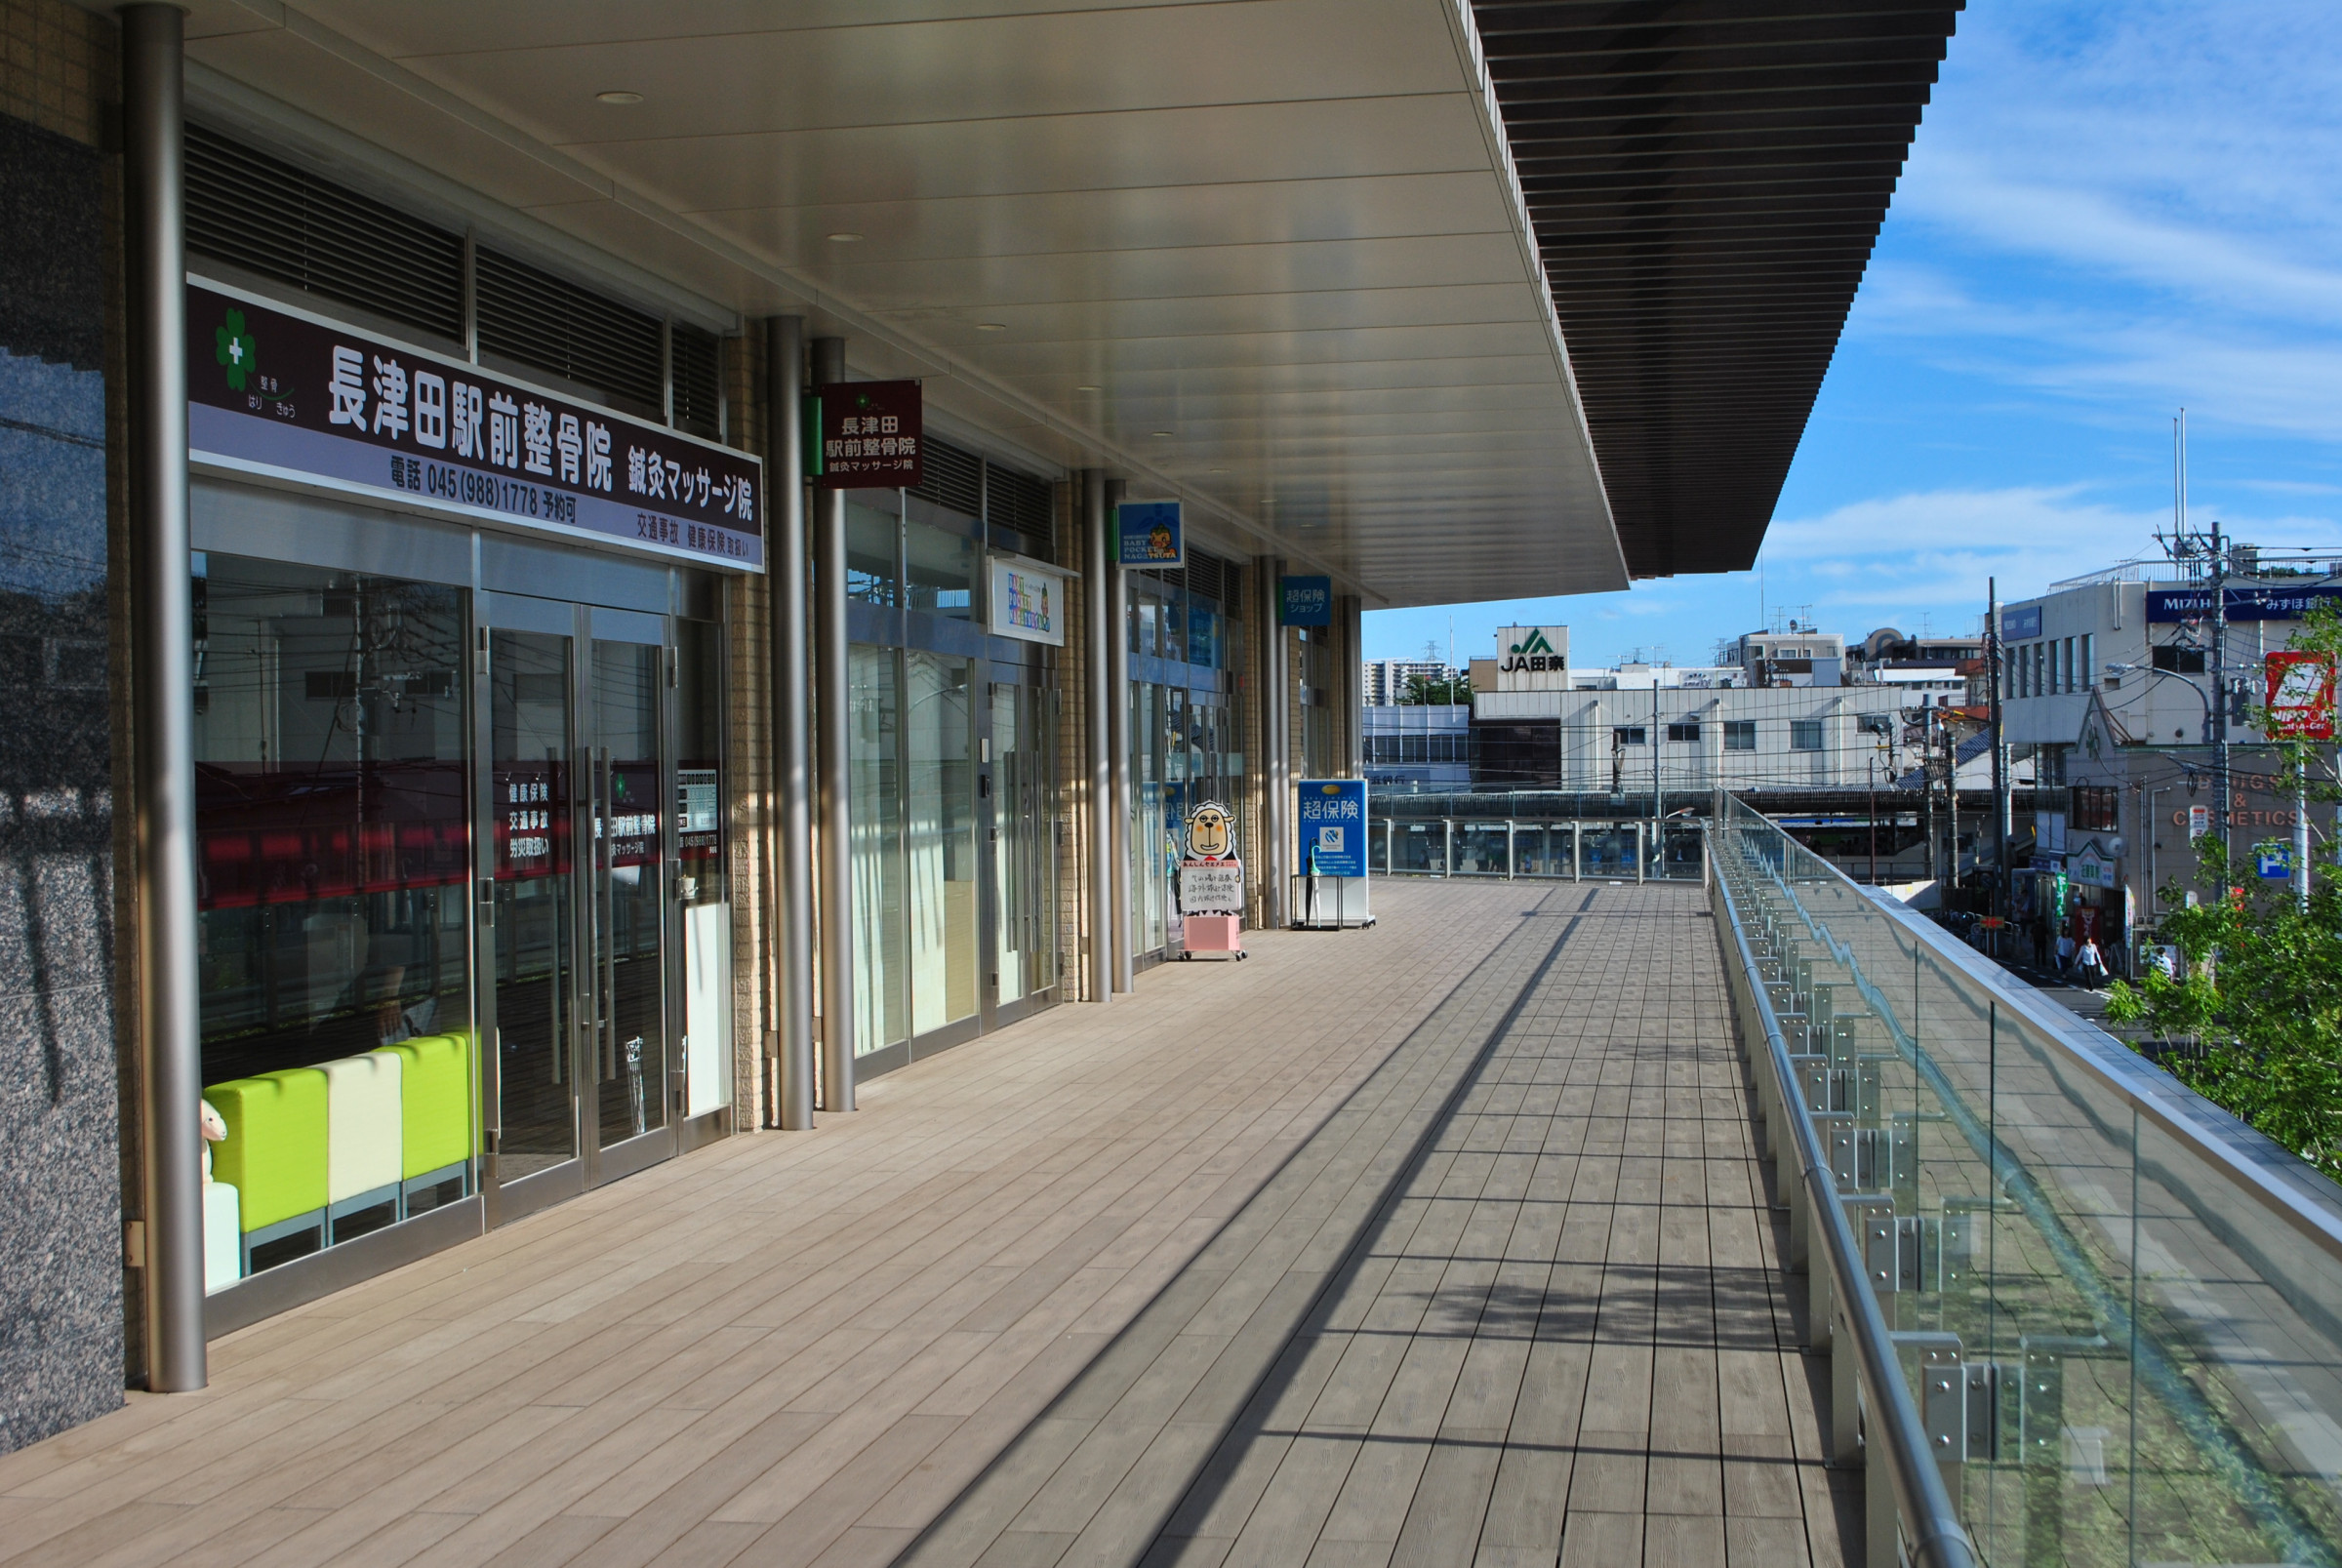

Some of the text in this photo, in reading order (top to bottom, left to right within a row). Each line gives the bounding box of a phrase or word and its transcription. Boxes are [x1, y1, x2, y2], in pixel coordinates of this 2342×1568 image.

[248, 394, 296, 419] はり きゅう
[329, 345, 752, 522] 長津田駅前整骨院 鍼灸マッサージ院
[841, 416, 898, 435] 長津田
[827, 436, 916, 458] 駅前整骨院
[829, 459, 913, 472] 鍼灸マッサージ院
[391, 455, 576, 523] 電話 045(988)1778 予約可
[637, 512, 679, 545] 交通事故
[1286, 588, 1325, 603] 超保険
[2198, 775, 2280, 789] DUGS
[509, 783, 548, 803] 健康保険
[2234, 792, 2247, 808] &
[509, 810, 548, 830] 交通事故
[1303, 800, 1359, 820] 超保険
[2173, 811, 2298, 826] CSETICS
[594, 814, 656, 838] 長田駅前整骨院
[509, 836, 549, 859] 労災取扱い
